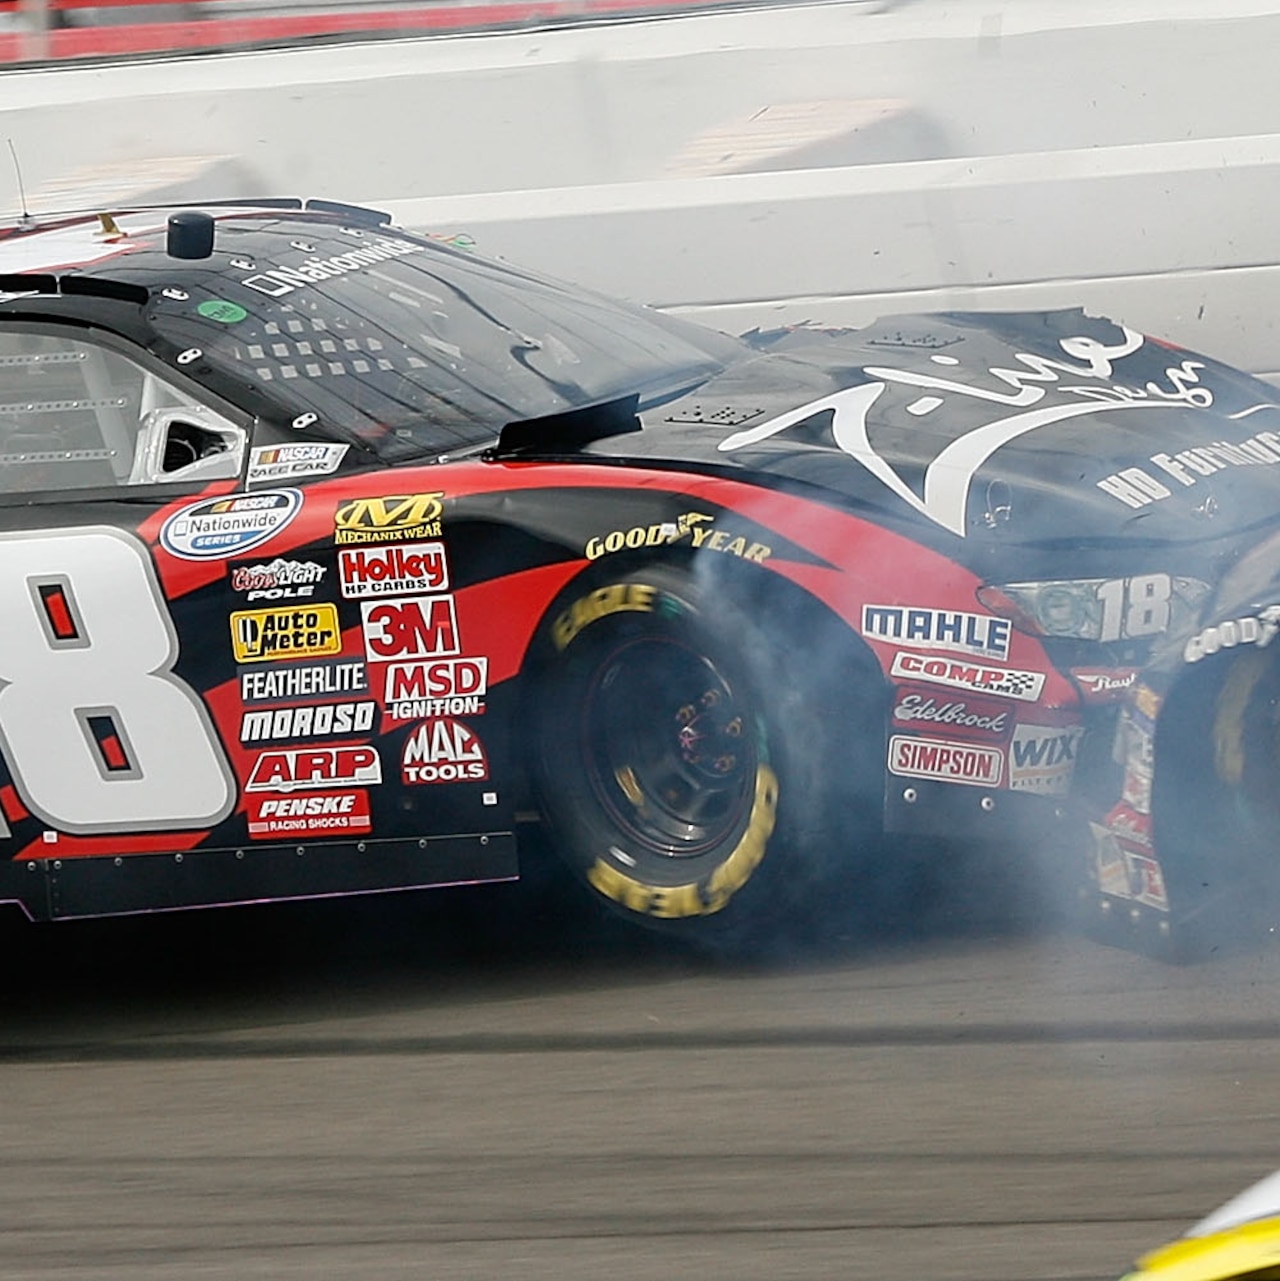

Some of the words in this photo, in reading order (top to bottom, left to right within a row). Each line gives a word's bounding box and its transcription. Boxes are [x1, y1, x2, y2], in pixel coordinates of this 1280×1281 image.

[269, 238, 425, 288] Nationwide
[278, 448, 329, 463] NASCAR
[1096, 467, 1172, 509] HD
[189, 513, 278, 533] Nationwide
[335, 529, 403, 544] MECHANIX
[403, 522, 443, 540] WEAR
[195, 535, 241, 547] SERIES
[342, 548, 443, 586] Holley
[247, 585, 315, 601] POLE
[345, 584, 367, 594] HP
[371, 579, 427, 592] CARBS
[262, 612, 318, 632] Auto
[1096, 572, 1171, 643] 18
[260, 629, 333, 655] Meter
[368, 600, 455, 656] 3M
[865, 607, 1010, 652] MAHLE
[392, 661, 482, 702] MSD
[900, 656, 1006, 685] COMP
[971, 681, 1024, 696] CAMS
[240, 701, 376, 741] MOROSO
[392, 694, 479, 720] IGNITION
[894, 695, 1008, 733] Edelbrock
[403, 720, 483, 765] MAC
[1013, 732, 1076, 768] WIX
[252, 748, 376, 784] ARP
[404, 764, 484, 781] TOOLS
[898, 742, 993, 779] SIMPSON
[259, 795, 356, 818] PENSKE
[270, 820, 307, 832] RACING
[308, 817, 349, 829] SHOCKS
